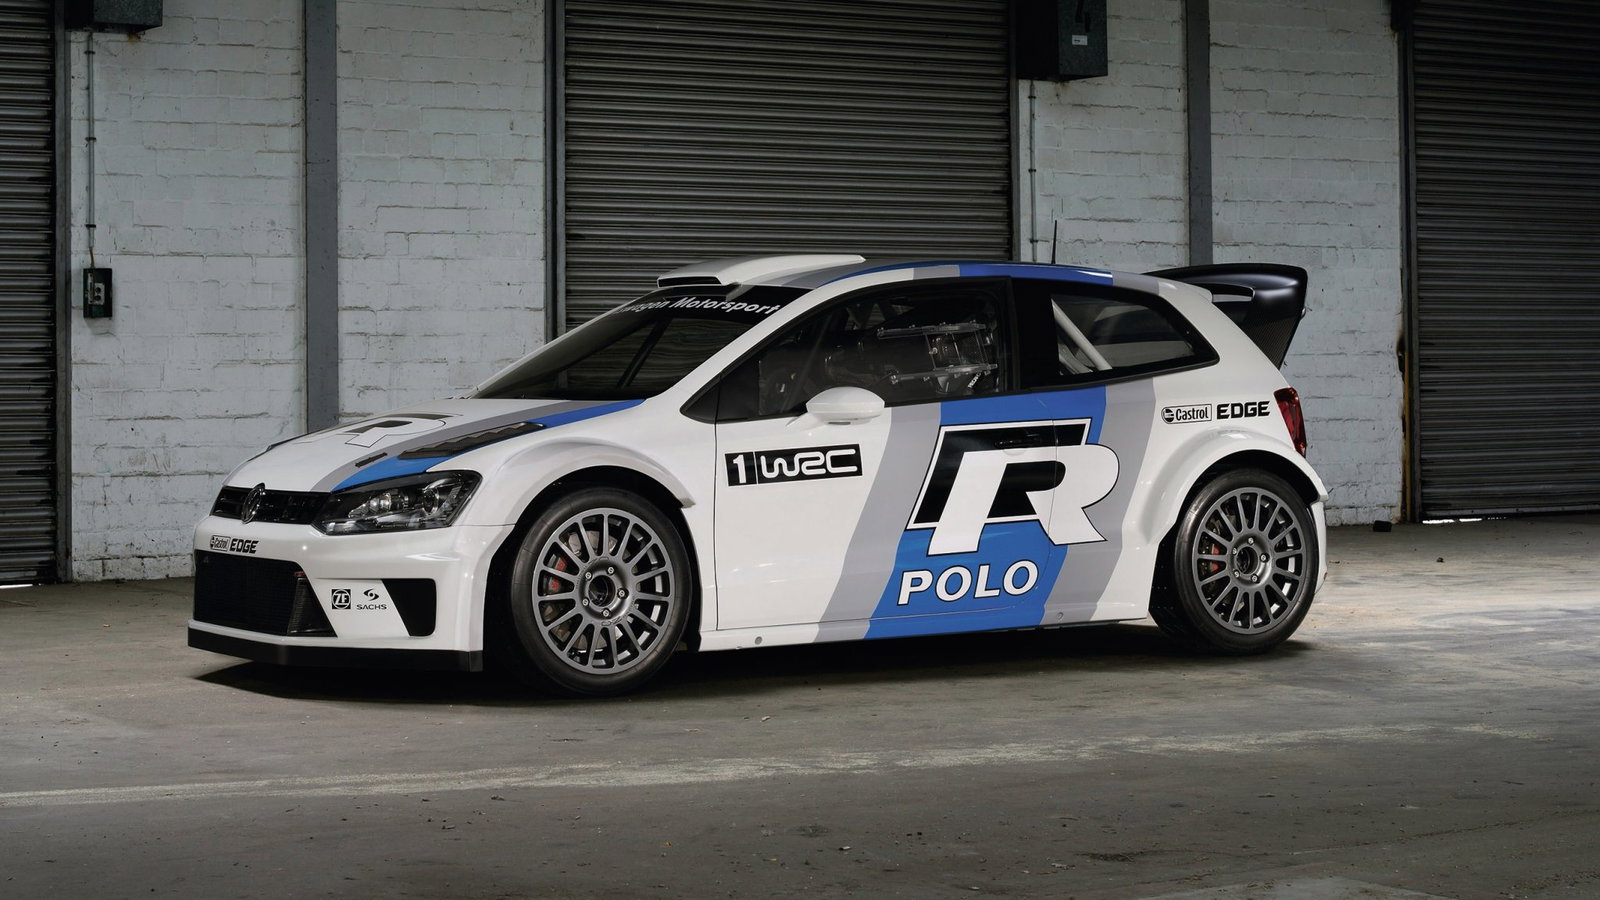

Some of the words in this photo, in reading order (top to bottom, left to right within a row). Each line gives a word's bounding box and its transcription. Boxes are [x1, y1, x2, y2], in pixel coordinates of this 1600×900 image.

[669, 296, 781, 315] Motorsport
[1175, 406, 1209, 421] Castrol
[1216, 400, 1270, 420] EDGE
[732, 454, 747, 484] 1
[760, 448, 858, 479] WRC
[926, 444, 1120, 557] R
[229, 538, 259, 554] EDGE
[896, 559, 1039, 606] POLO
[334, 593, 349, 605] ZF
